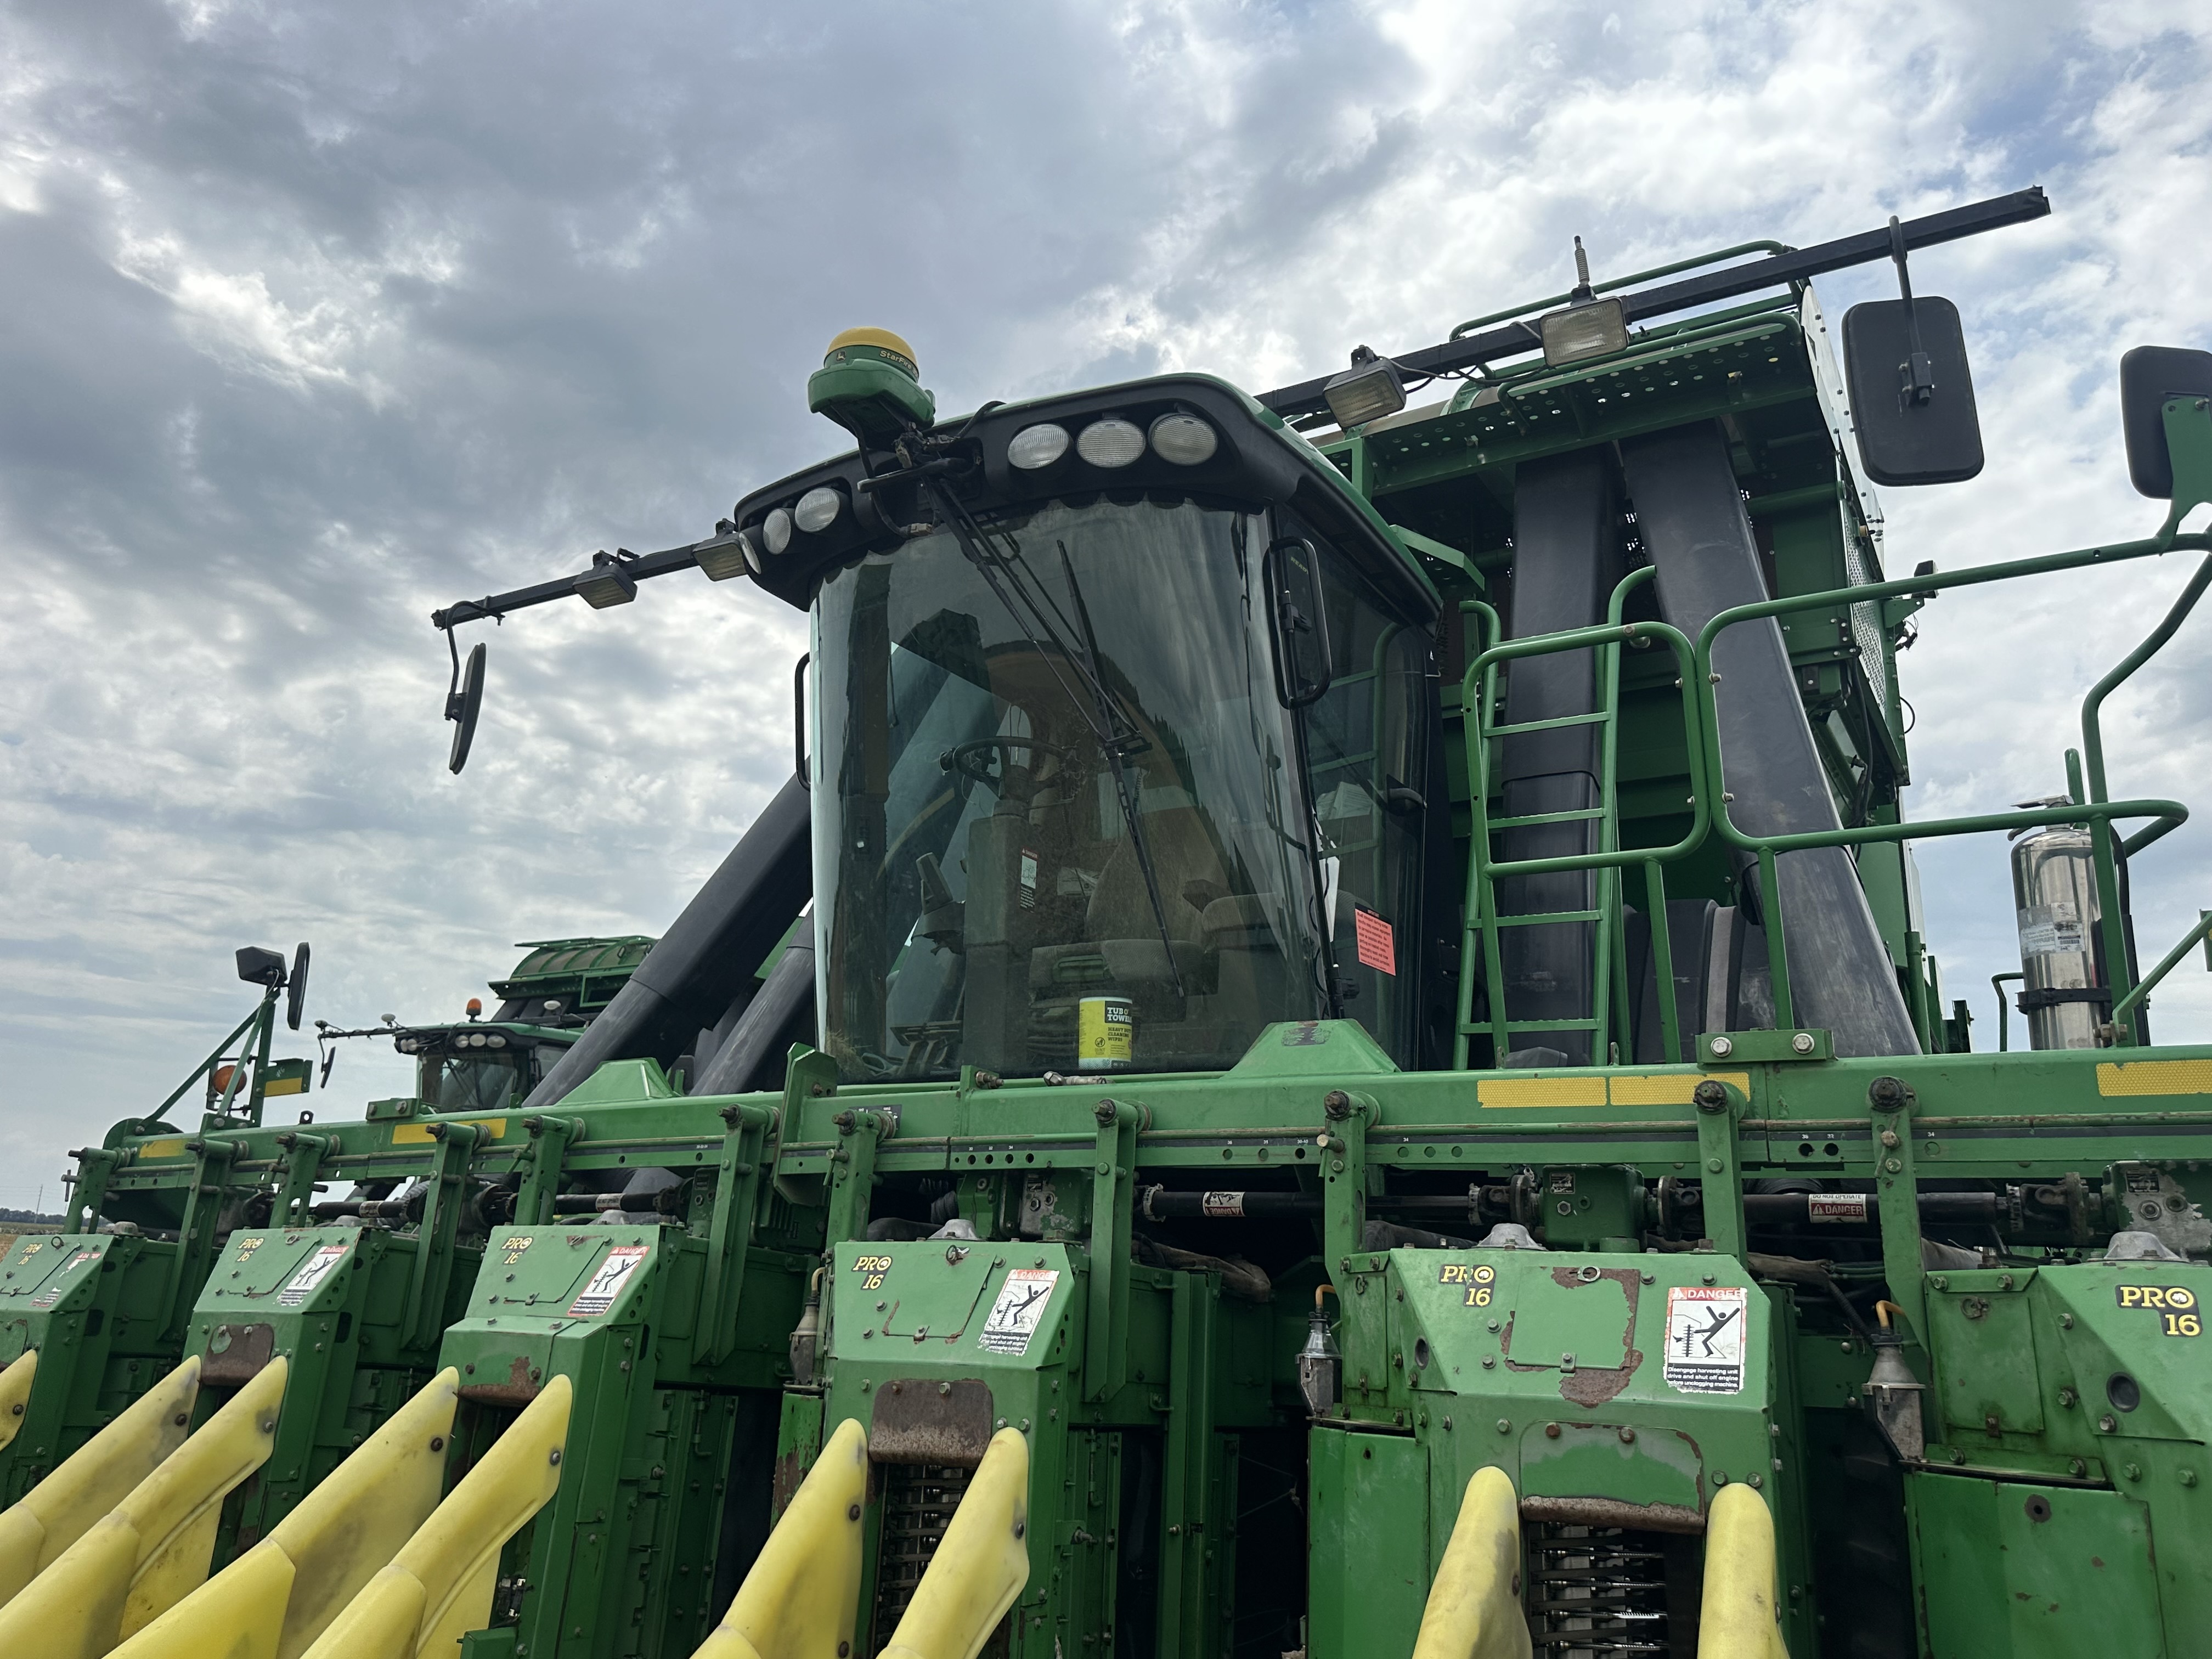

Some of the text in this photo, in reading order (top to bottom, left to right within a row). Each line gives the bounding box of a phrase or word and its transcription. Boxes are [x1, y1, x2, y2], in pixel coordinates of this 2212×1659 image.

[879, 350, 912, 370] StarFire
[1825, 1205, 1863, 1215] DANGER
[238, 1238, 264, 1249] PRO
[501, 1237, 533, 1249] PRO
[236, 1251, 254, 1262] 16
[504, 1251, 523, 1264] 16
[853, 1256, 892, 1271] PRO
[862, 1274, 884, 1289] 16
[1020, 1271, 1053, 1280] DANGE
[1465, 1288, 1491, 1307] 16
[1687, 1289, 1741, 1300] DANGER
[2120, 1286, 2194, 1308] PRO
[2165, 1314, 2200, 1336] 16
